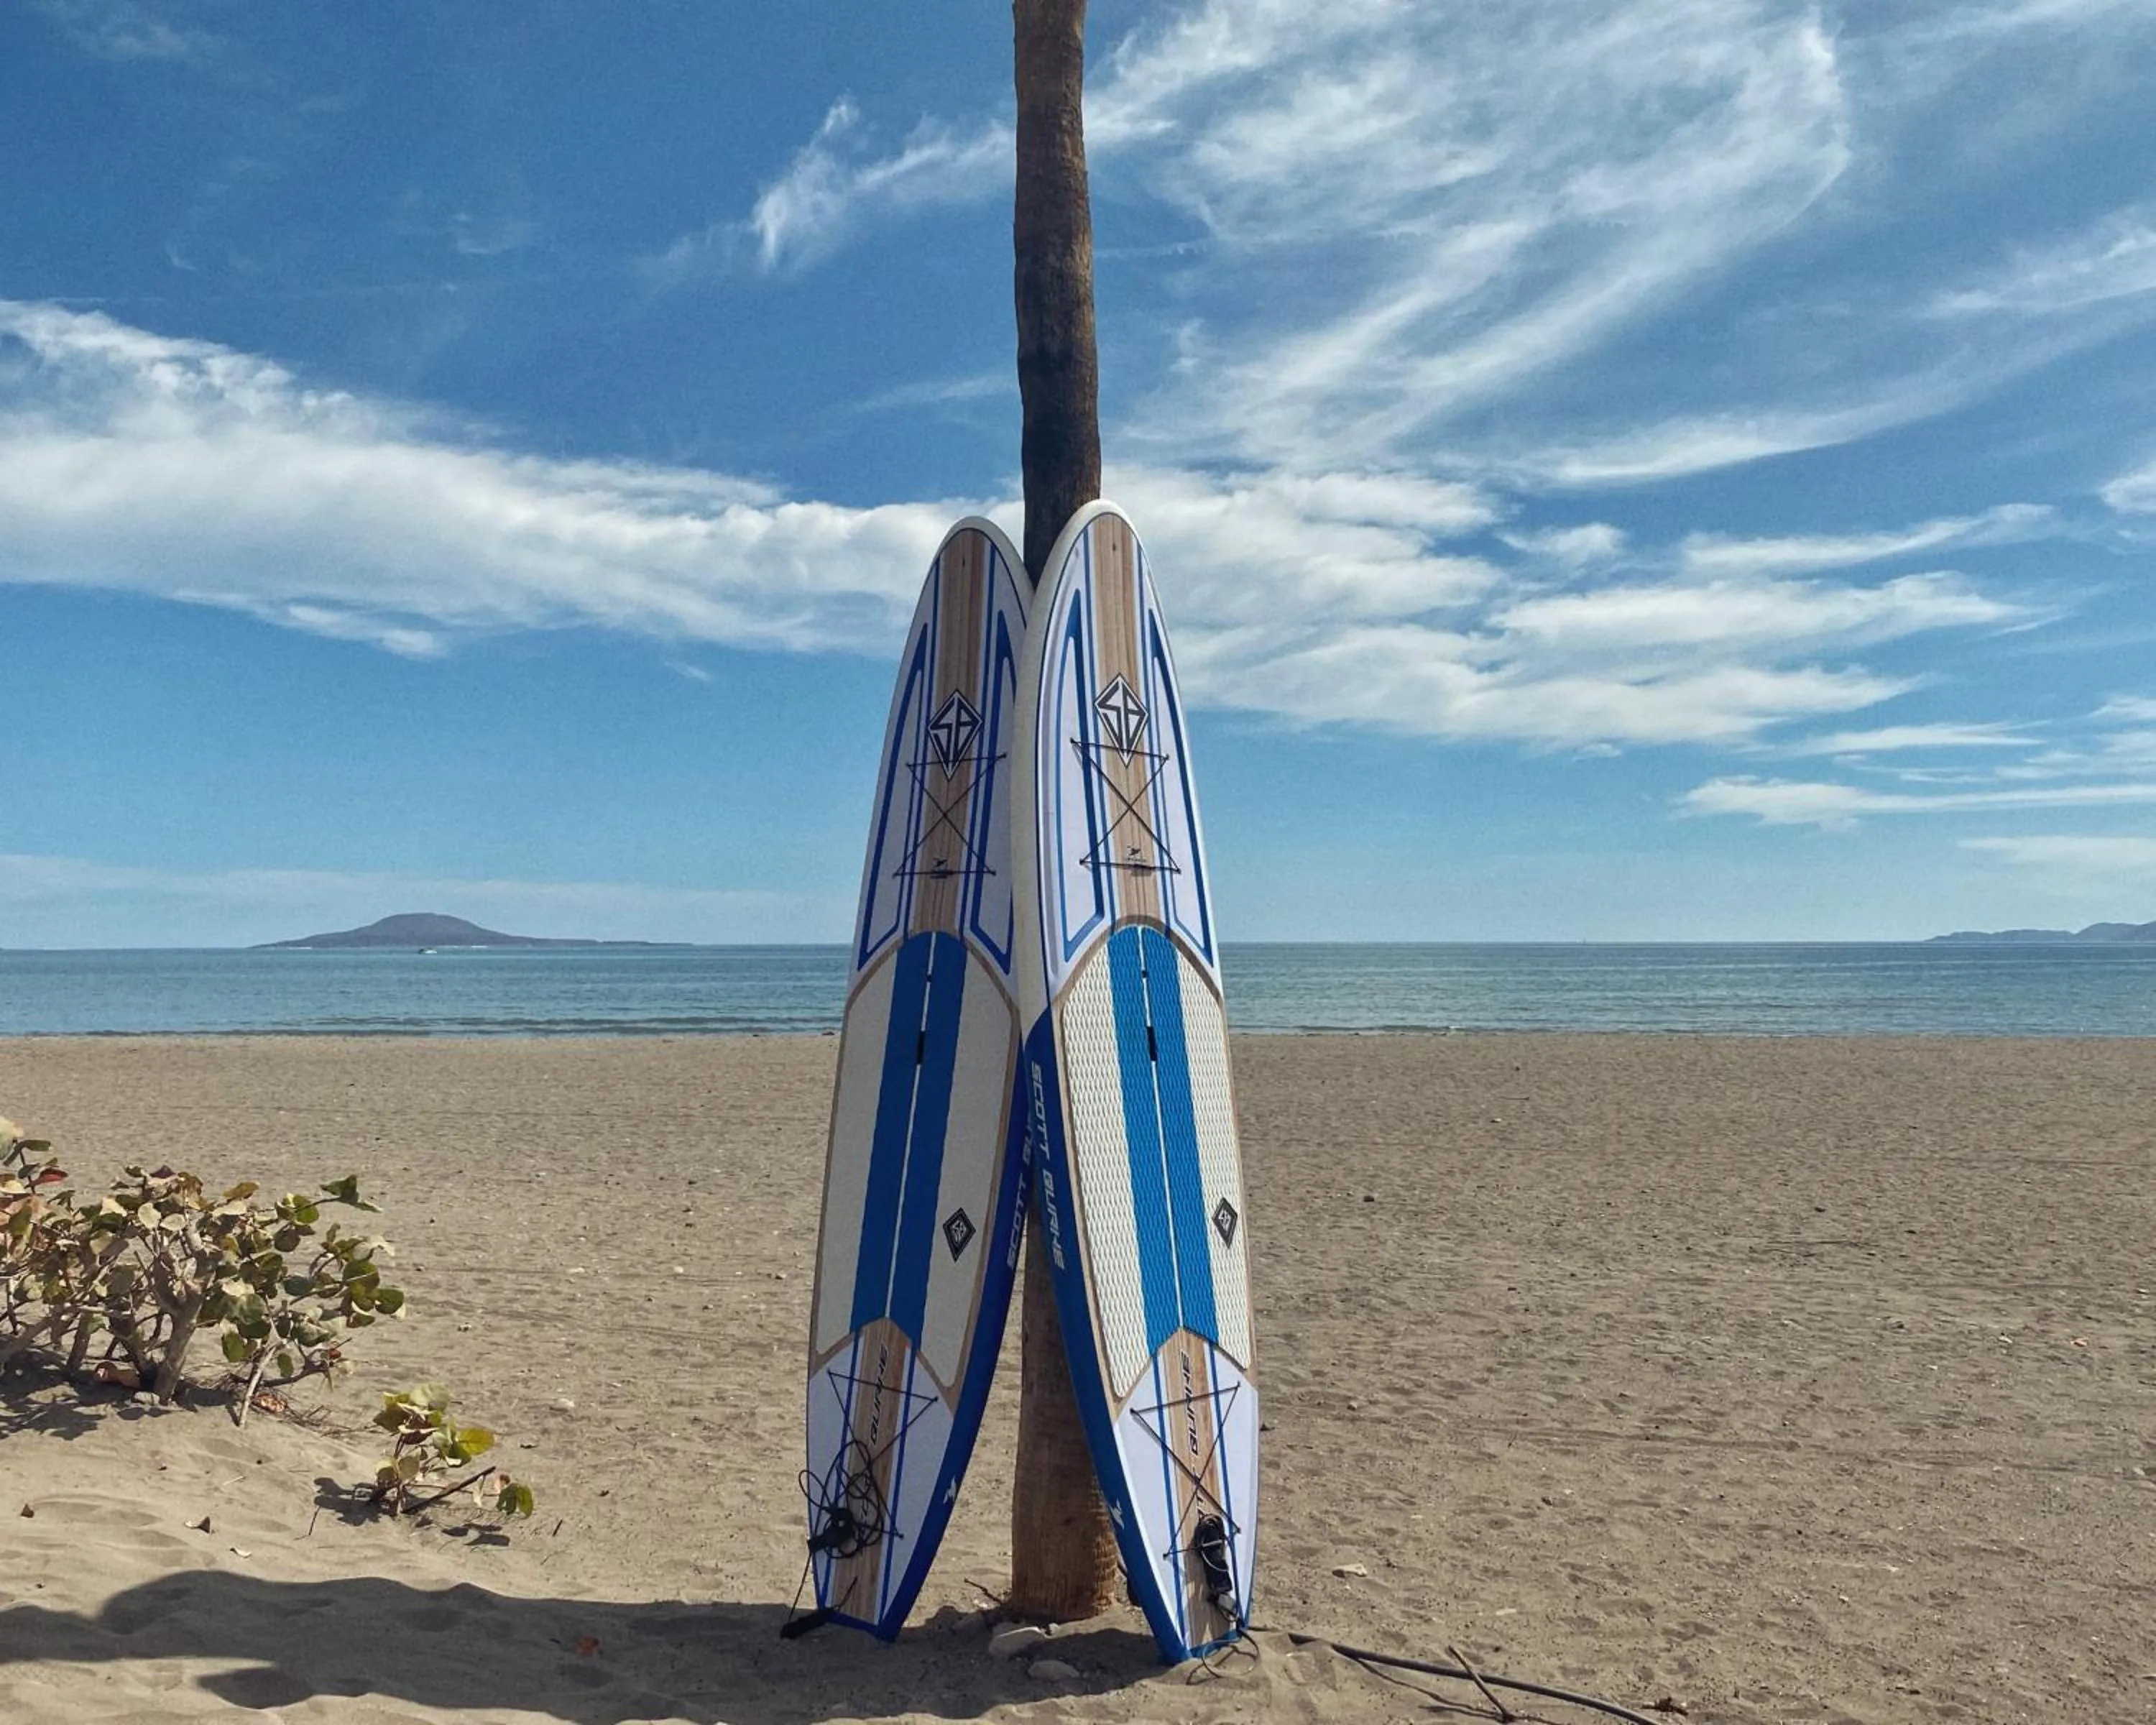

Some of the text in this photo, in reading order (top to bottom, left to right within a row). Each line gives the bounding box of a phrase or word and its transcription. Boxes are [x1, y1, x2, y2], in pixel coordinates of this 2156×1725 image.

[1007, 1172, 1026, 1270] SCOTT
[1031, 1059, 1065, 1270] SCOTT BURKE
